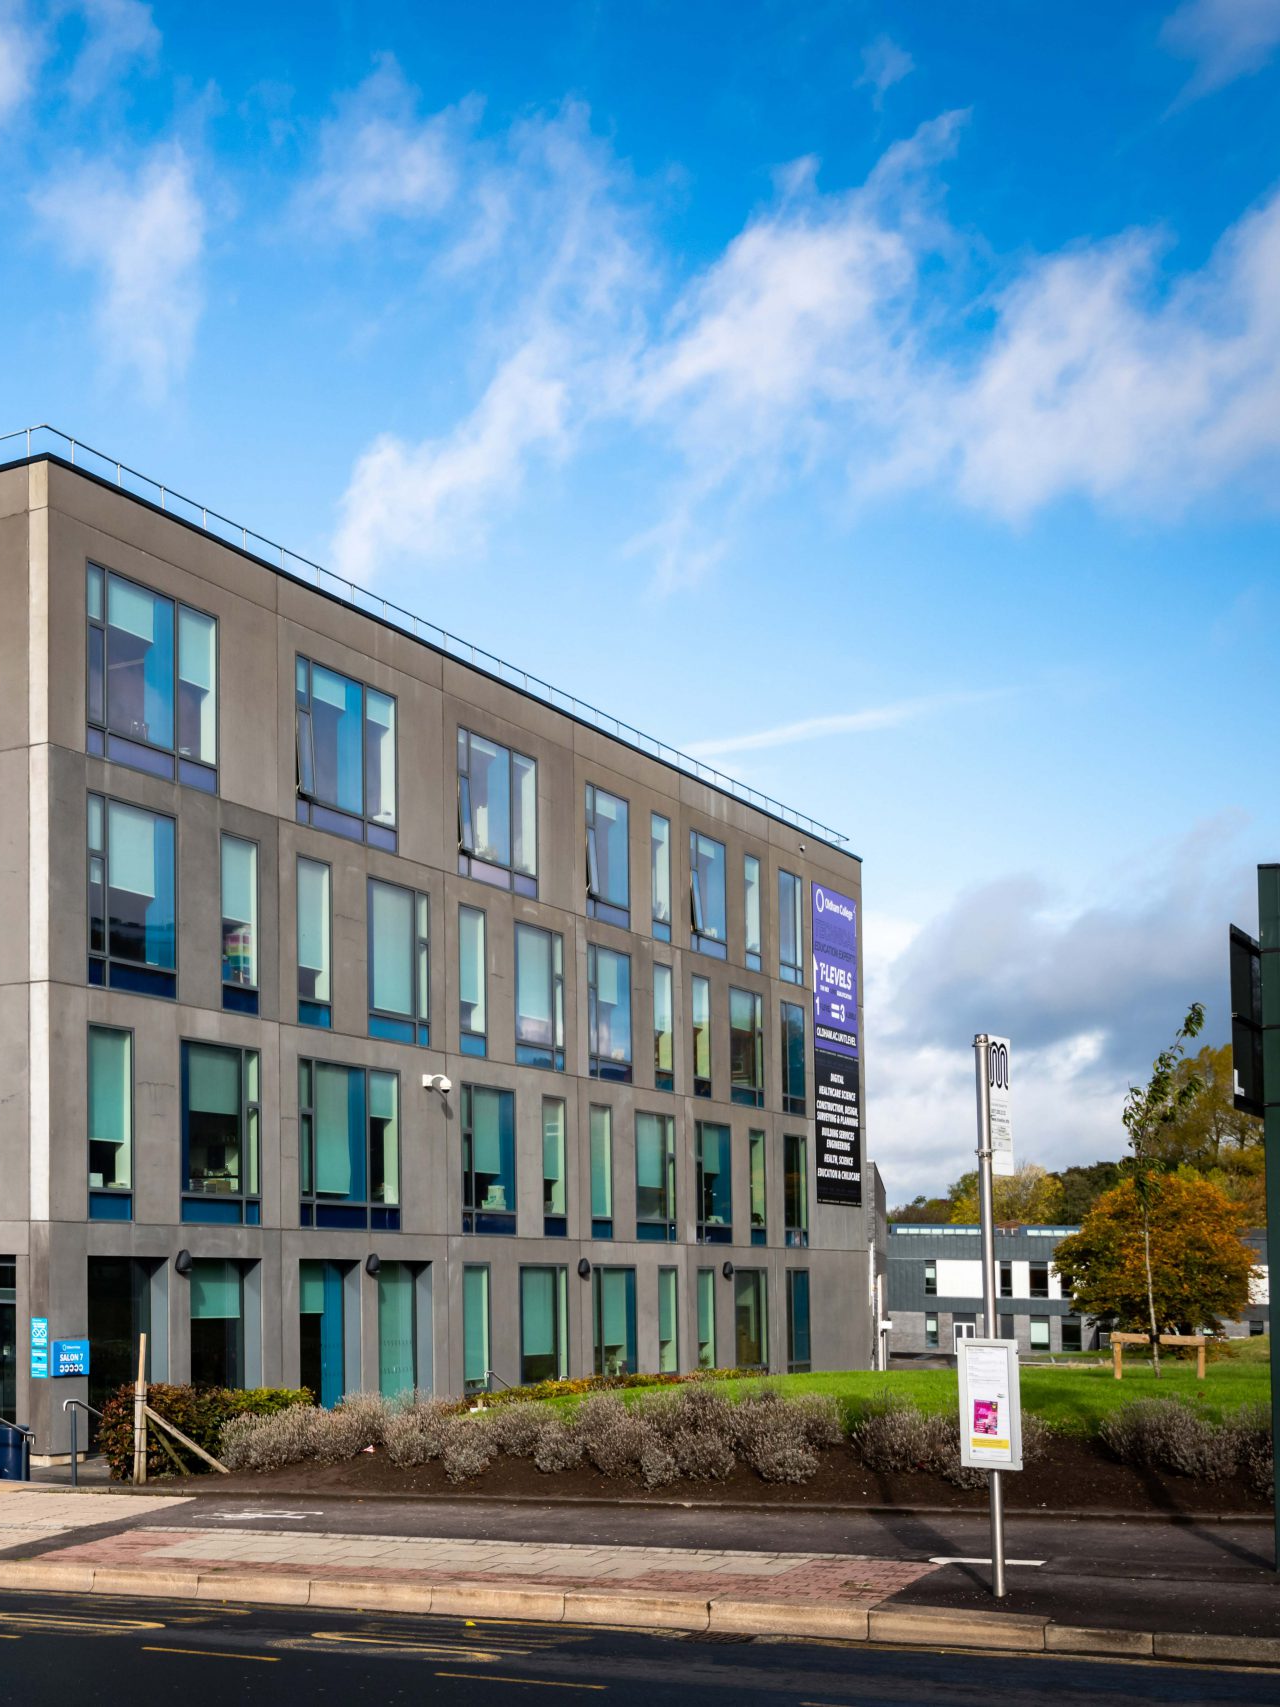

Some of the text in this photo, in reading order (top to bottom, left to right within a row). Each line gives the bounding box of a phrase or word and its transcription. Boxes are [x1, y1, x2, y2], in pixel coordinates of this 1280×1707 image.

[825, 898, 853, 921] Oldham College
[820, 962, 852, 990] T-LEVELS
[840, 1004, 846, 1023] 3
[59, 1353, 84, 1362] SALON 7
